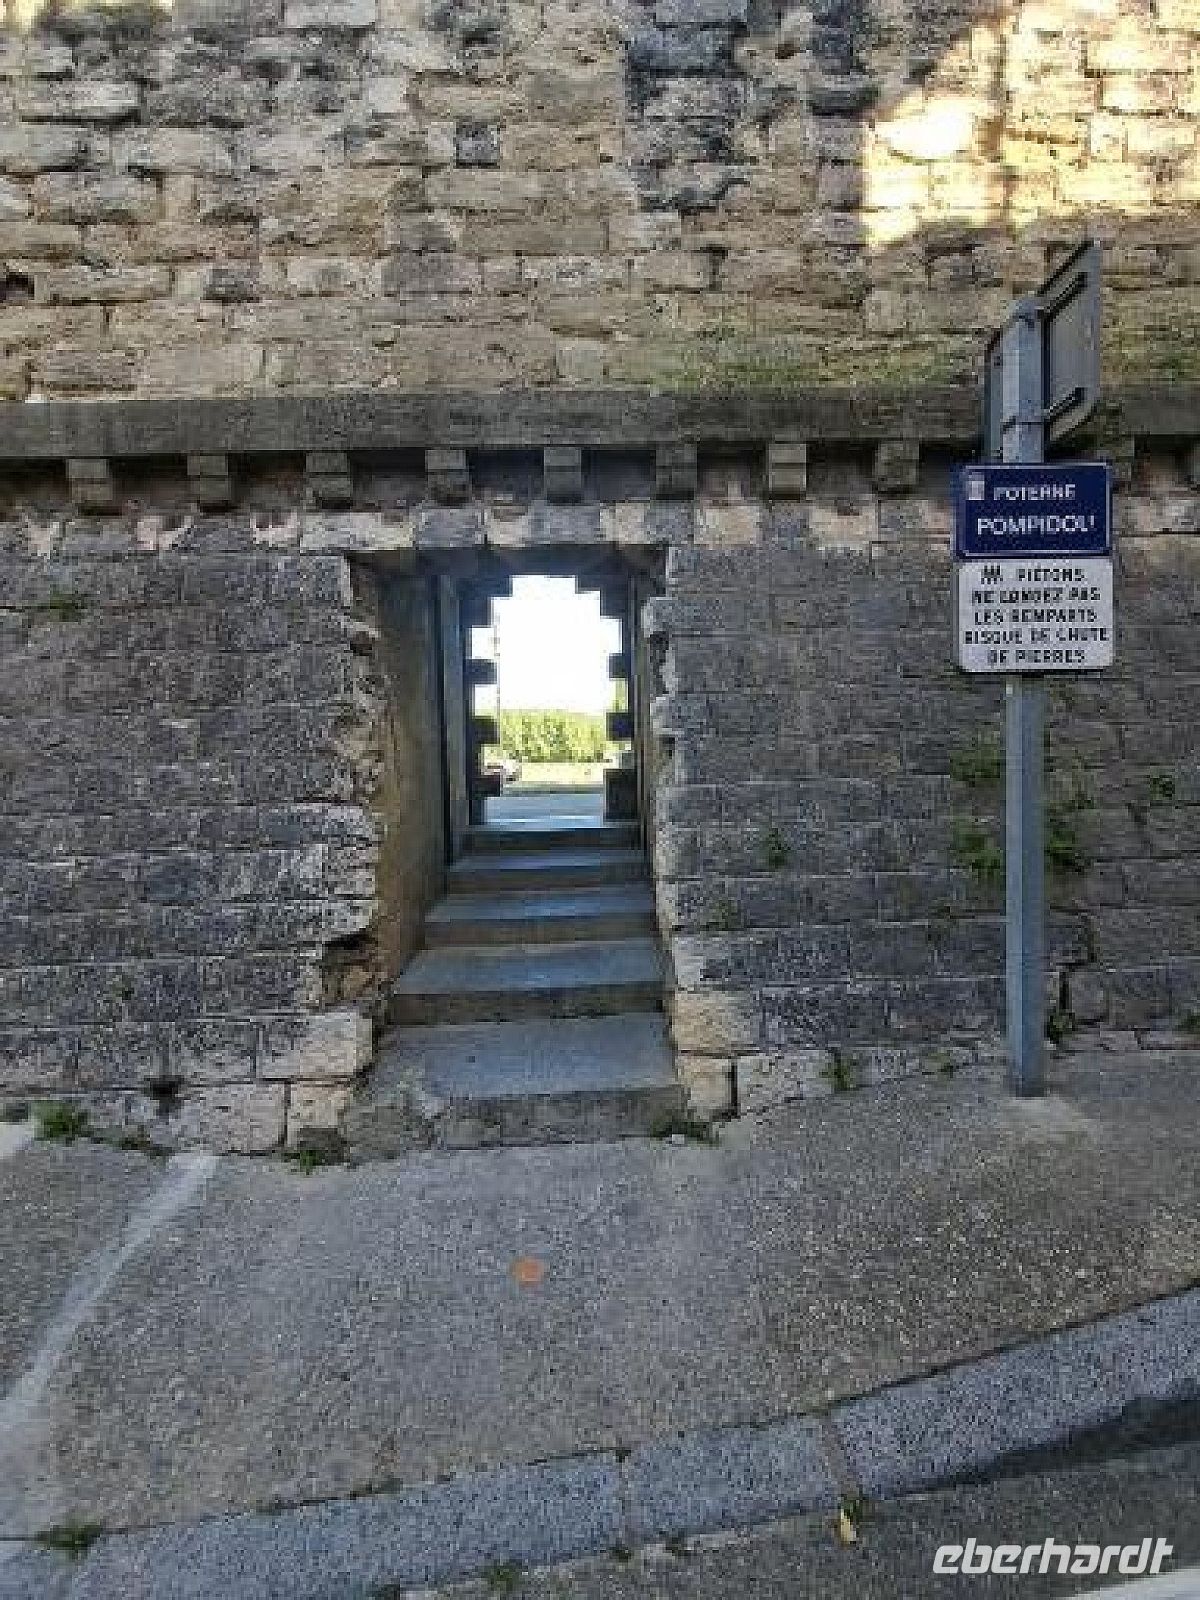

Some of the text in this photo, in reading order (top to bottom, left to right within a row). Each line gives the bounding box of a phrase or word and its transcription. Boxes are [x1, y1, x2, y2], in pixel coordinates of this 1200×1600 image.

[977, 515, 1097, 535] POMPIDOU
[974, 608, 1098, 625] LES REMPARTS
[964, 627, 1110, 645] RISQUE DE CHUTE
[1015, 649, 1086, 664] PIERRES
